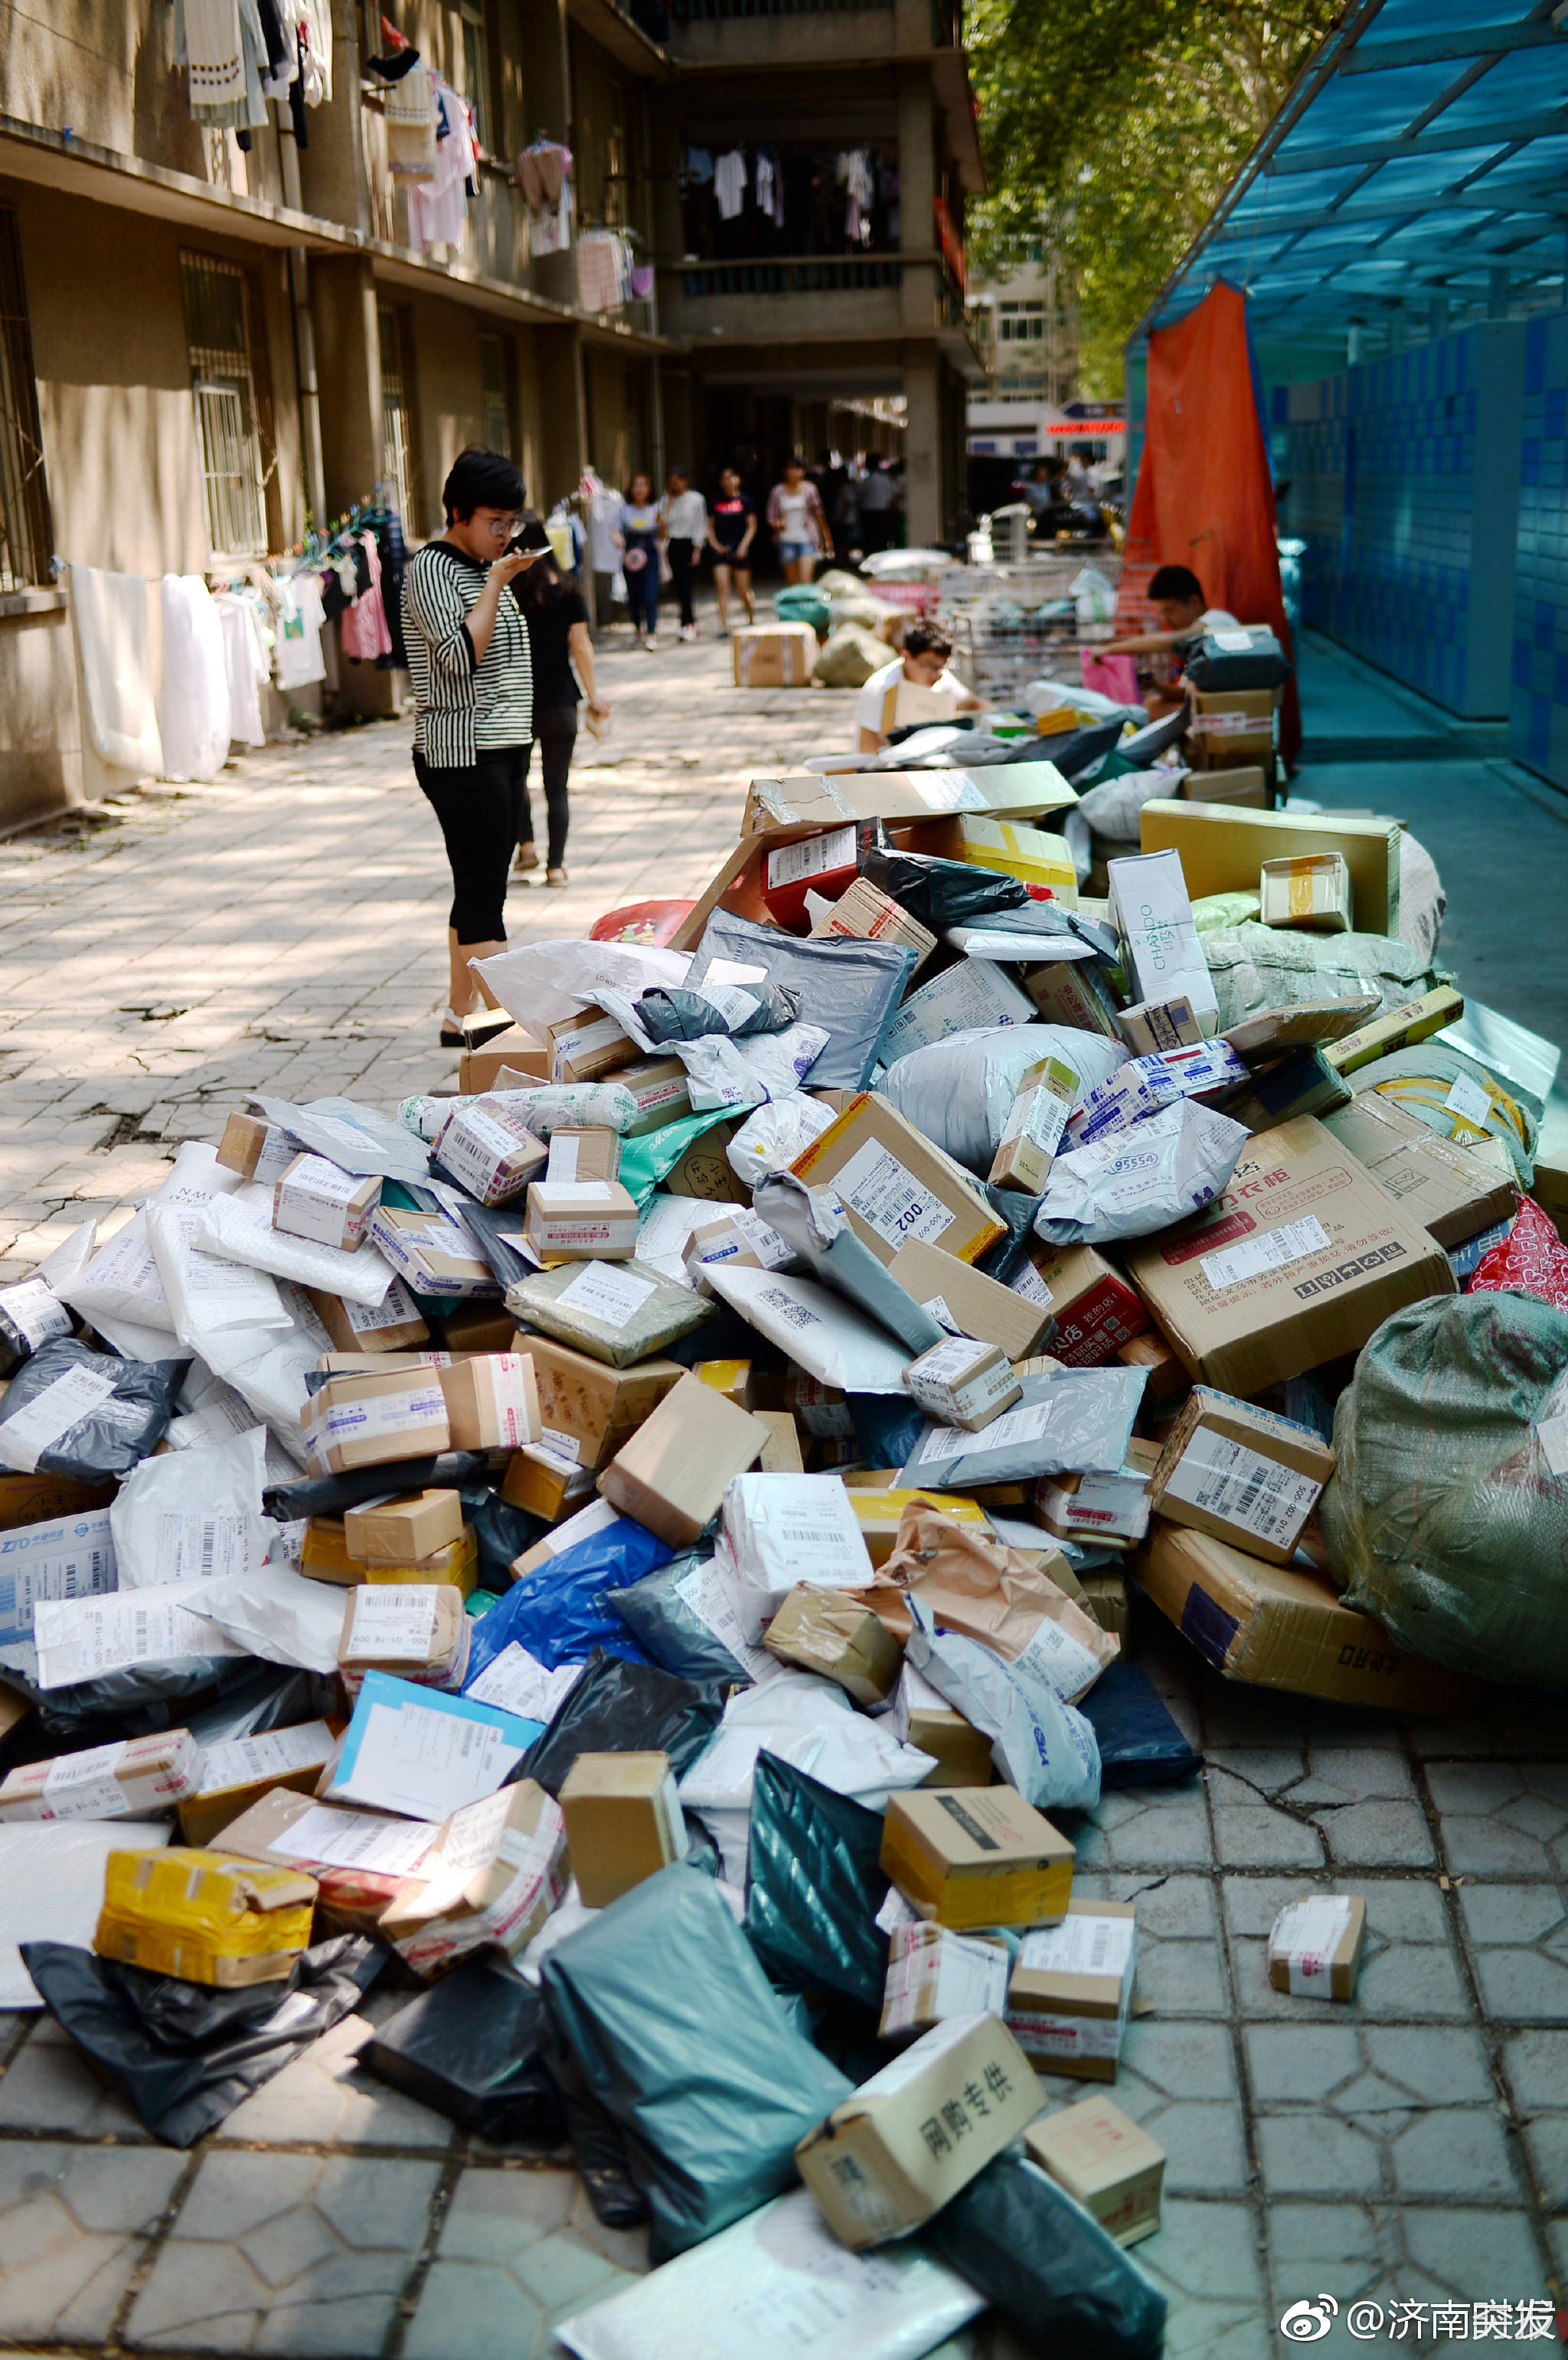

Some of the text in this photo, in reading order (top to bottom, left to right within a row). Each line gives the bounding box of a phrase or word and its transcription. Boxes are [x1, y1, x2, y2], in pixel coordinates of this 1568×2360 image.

[1140, 904, 1166, 970] CHANDO
[1114, 1154, 1157, 1172] 95554
[895, 1203, 925, 1231] 002
[1383, 1245, 1401, 1257] 16
[1274, 1484, 1308, 1535] 500-002 016
[1, 1537, 30, 1554] ZTO
[918, 2059, 1016, 2163] 网购专供
